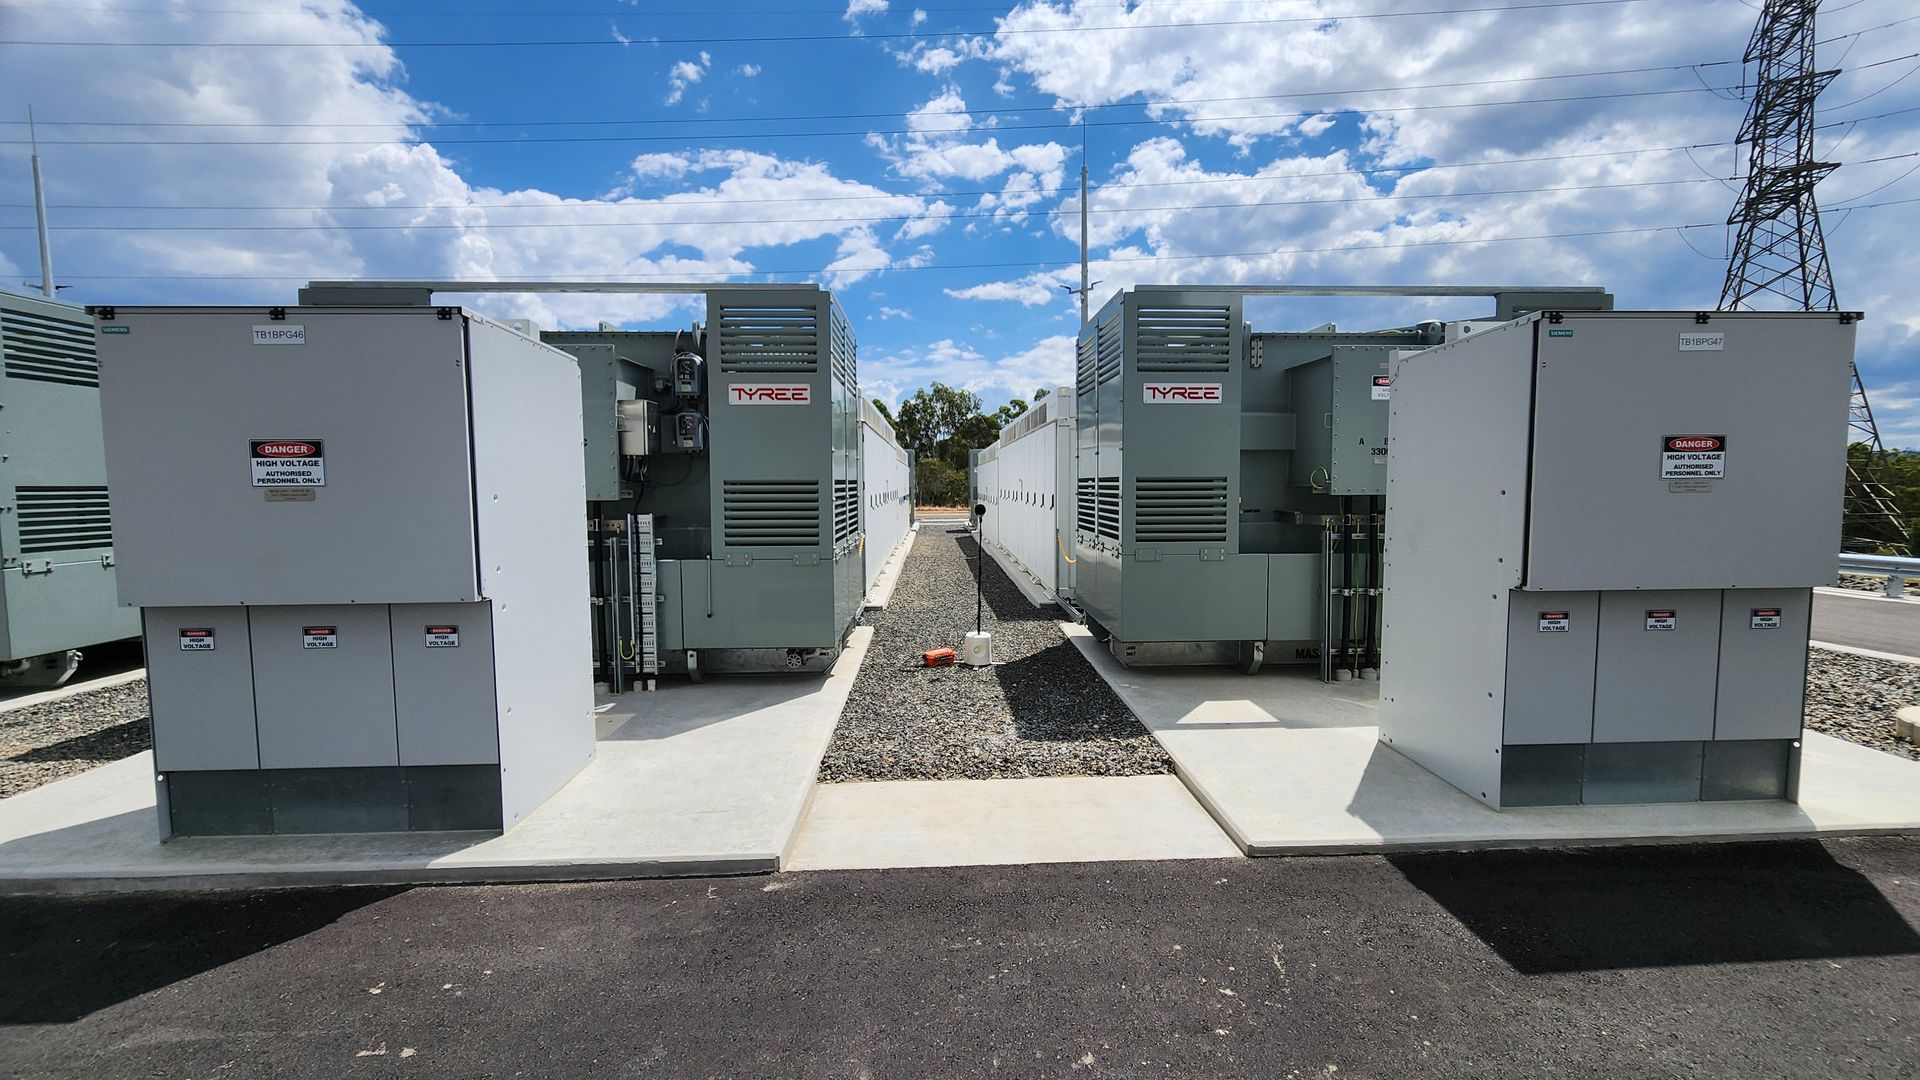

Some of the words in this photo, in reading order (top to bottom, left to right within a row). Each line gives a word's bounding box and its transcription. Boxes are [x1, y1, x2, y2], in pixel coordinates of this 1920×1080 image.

[254, 330, 304, 339] TB1BPG46
[1680, 337, 1723, 346] TB1BPG47
[730, 387, 808, 401] TYREE
[1145, 386, 1220, 400] TYREE
[1359, 437, 1365, 445] A
[1675, 440, 1713, 448] DANGER
